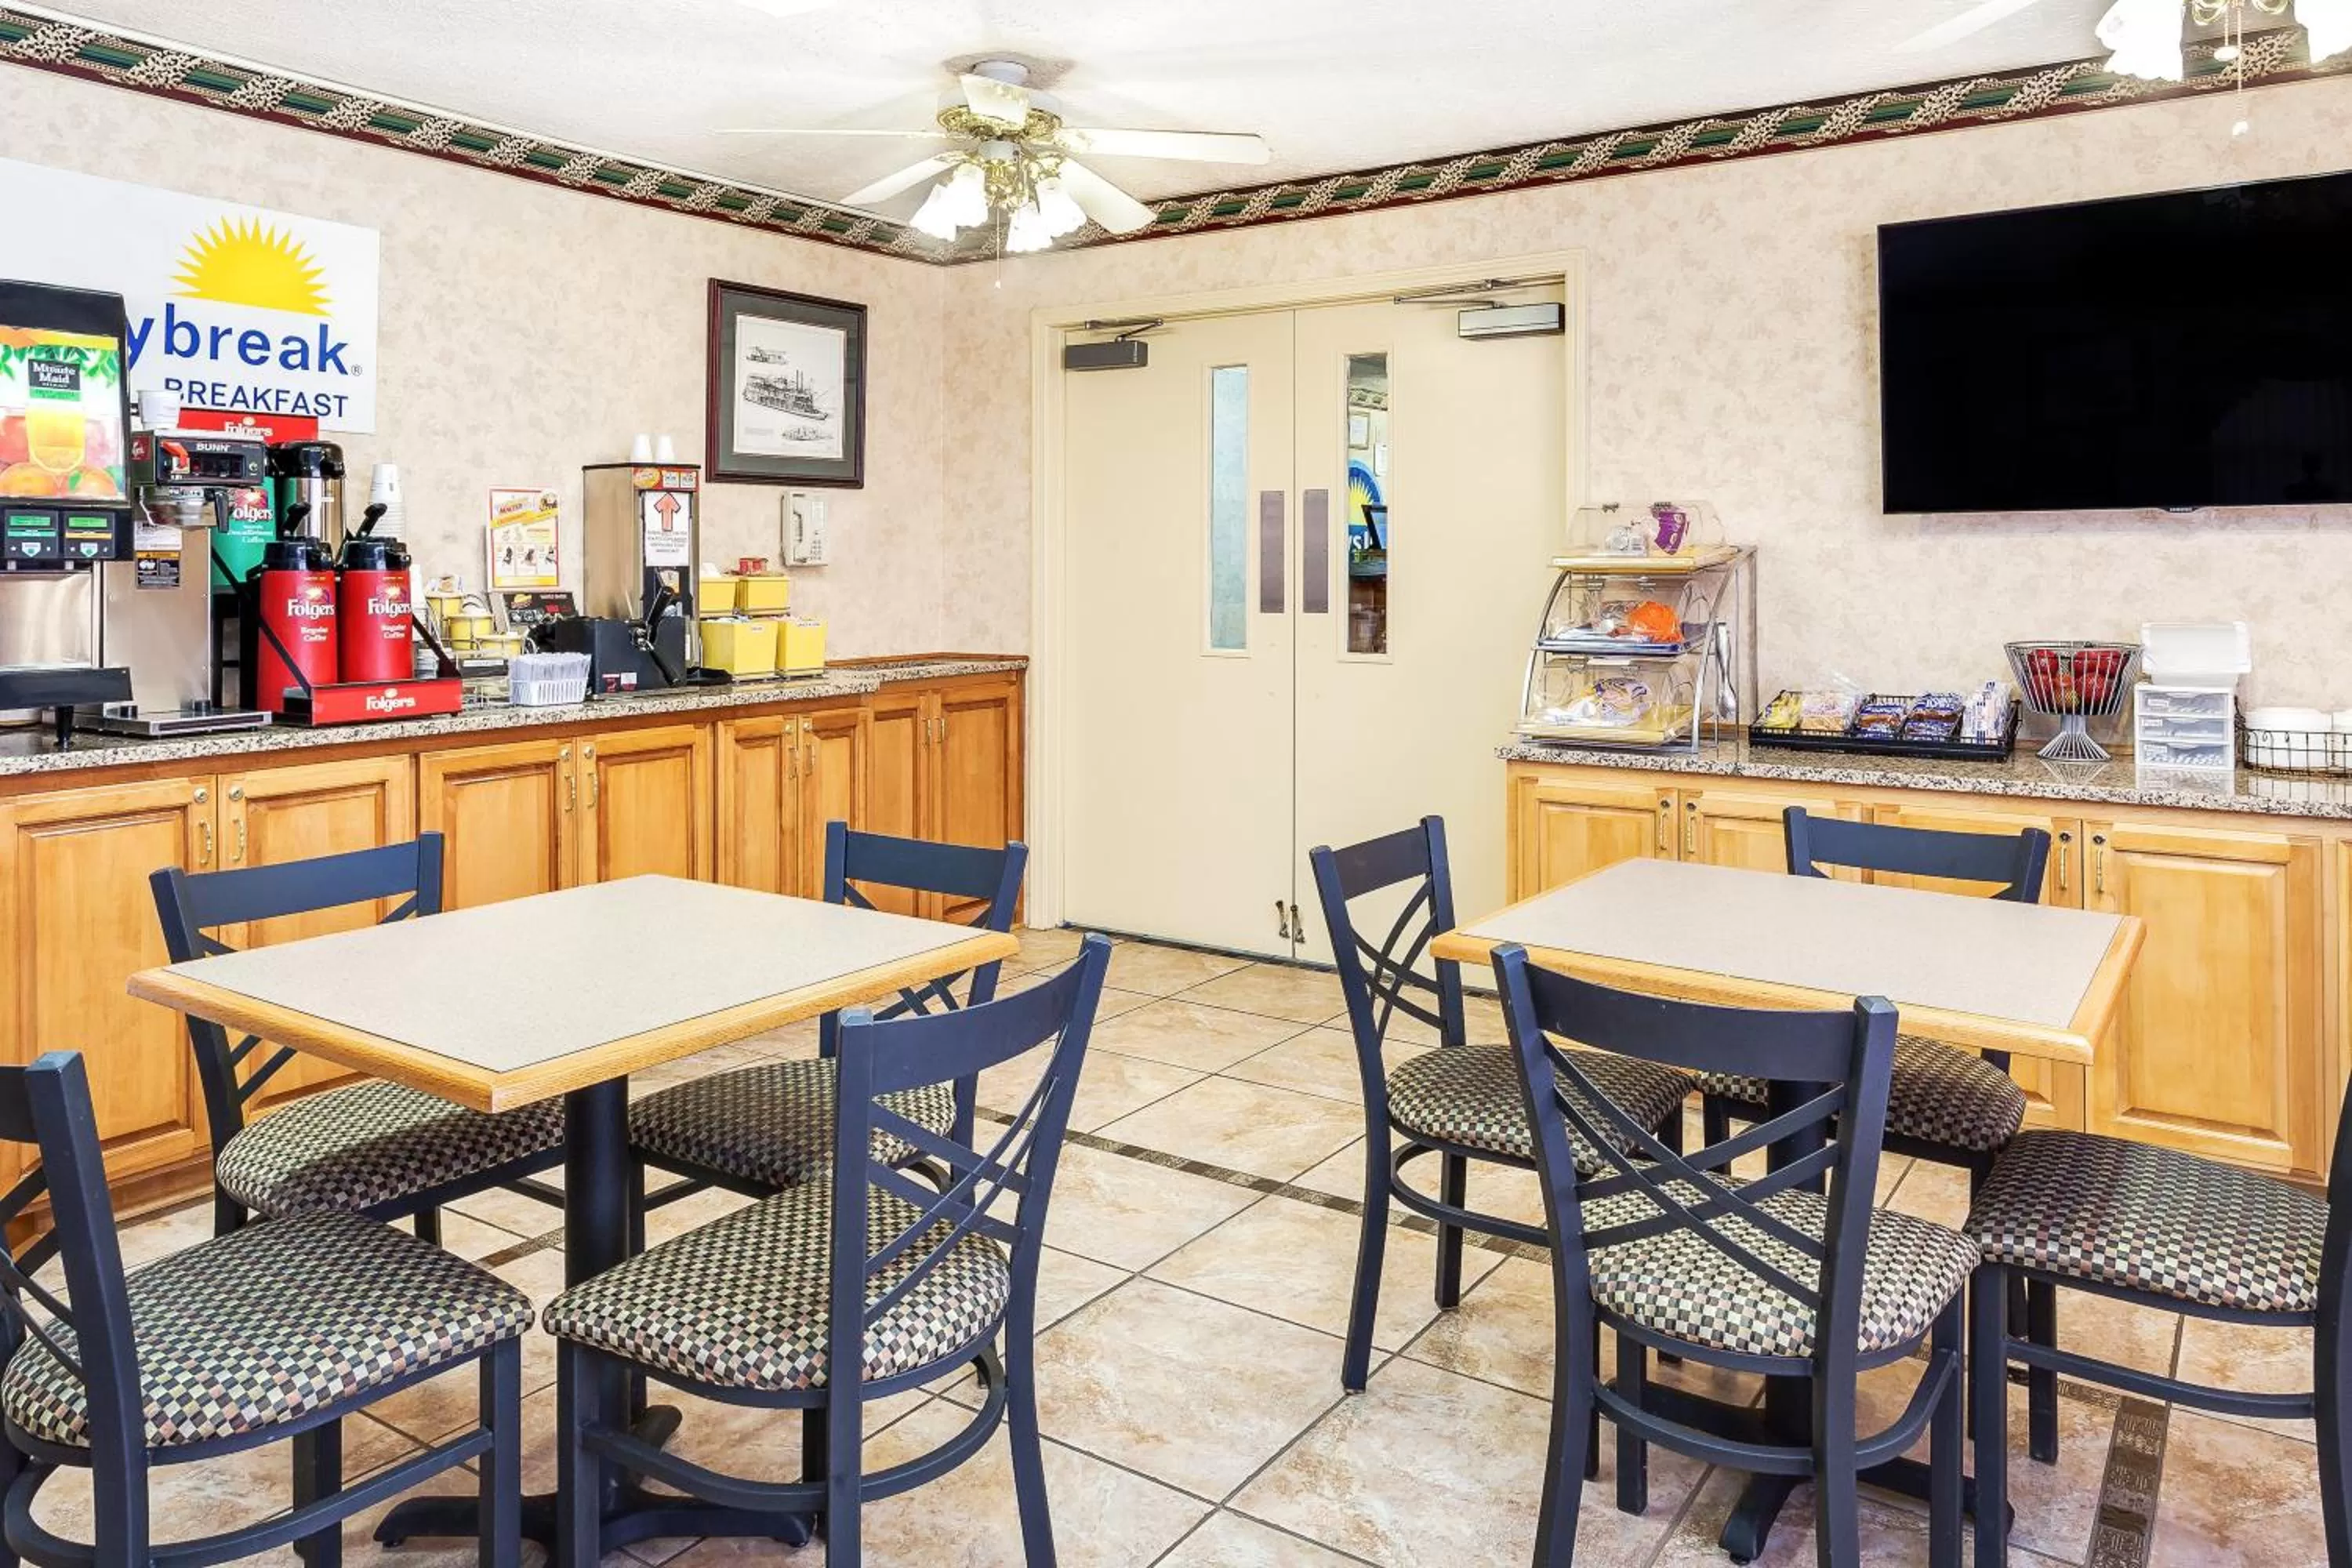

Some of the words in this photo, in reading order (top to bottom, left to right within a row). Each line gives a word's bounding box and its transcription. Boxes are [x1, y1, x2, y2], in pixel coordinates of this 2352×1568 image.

[164, 378, 349, 418] BREAKFAST
[196, 442, 229, 452] BUNN
[232, 503, 274, 523] olgers
[287, 598, 336, 620] Folgers
[368, 597, 412, 618] Folgers
[365, 696, 416, 712] Folgers
